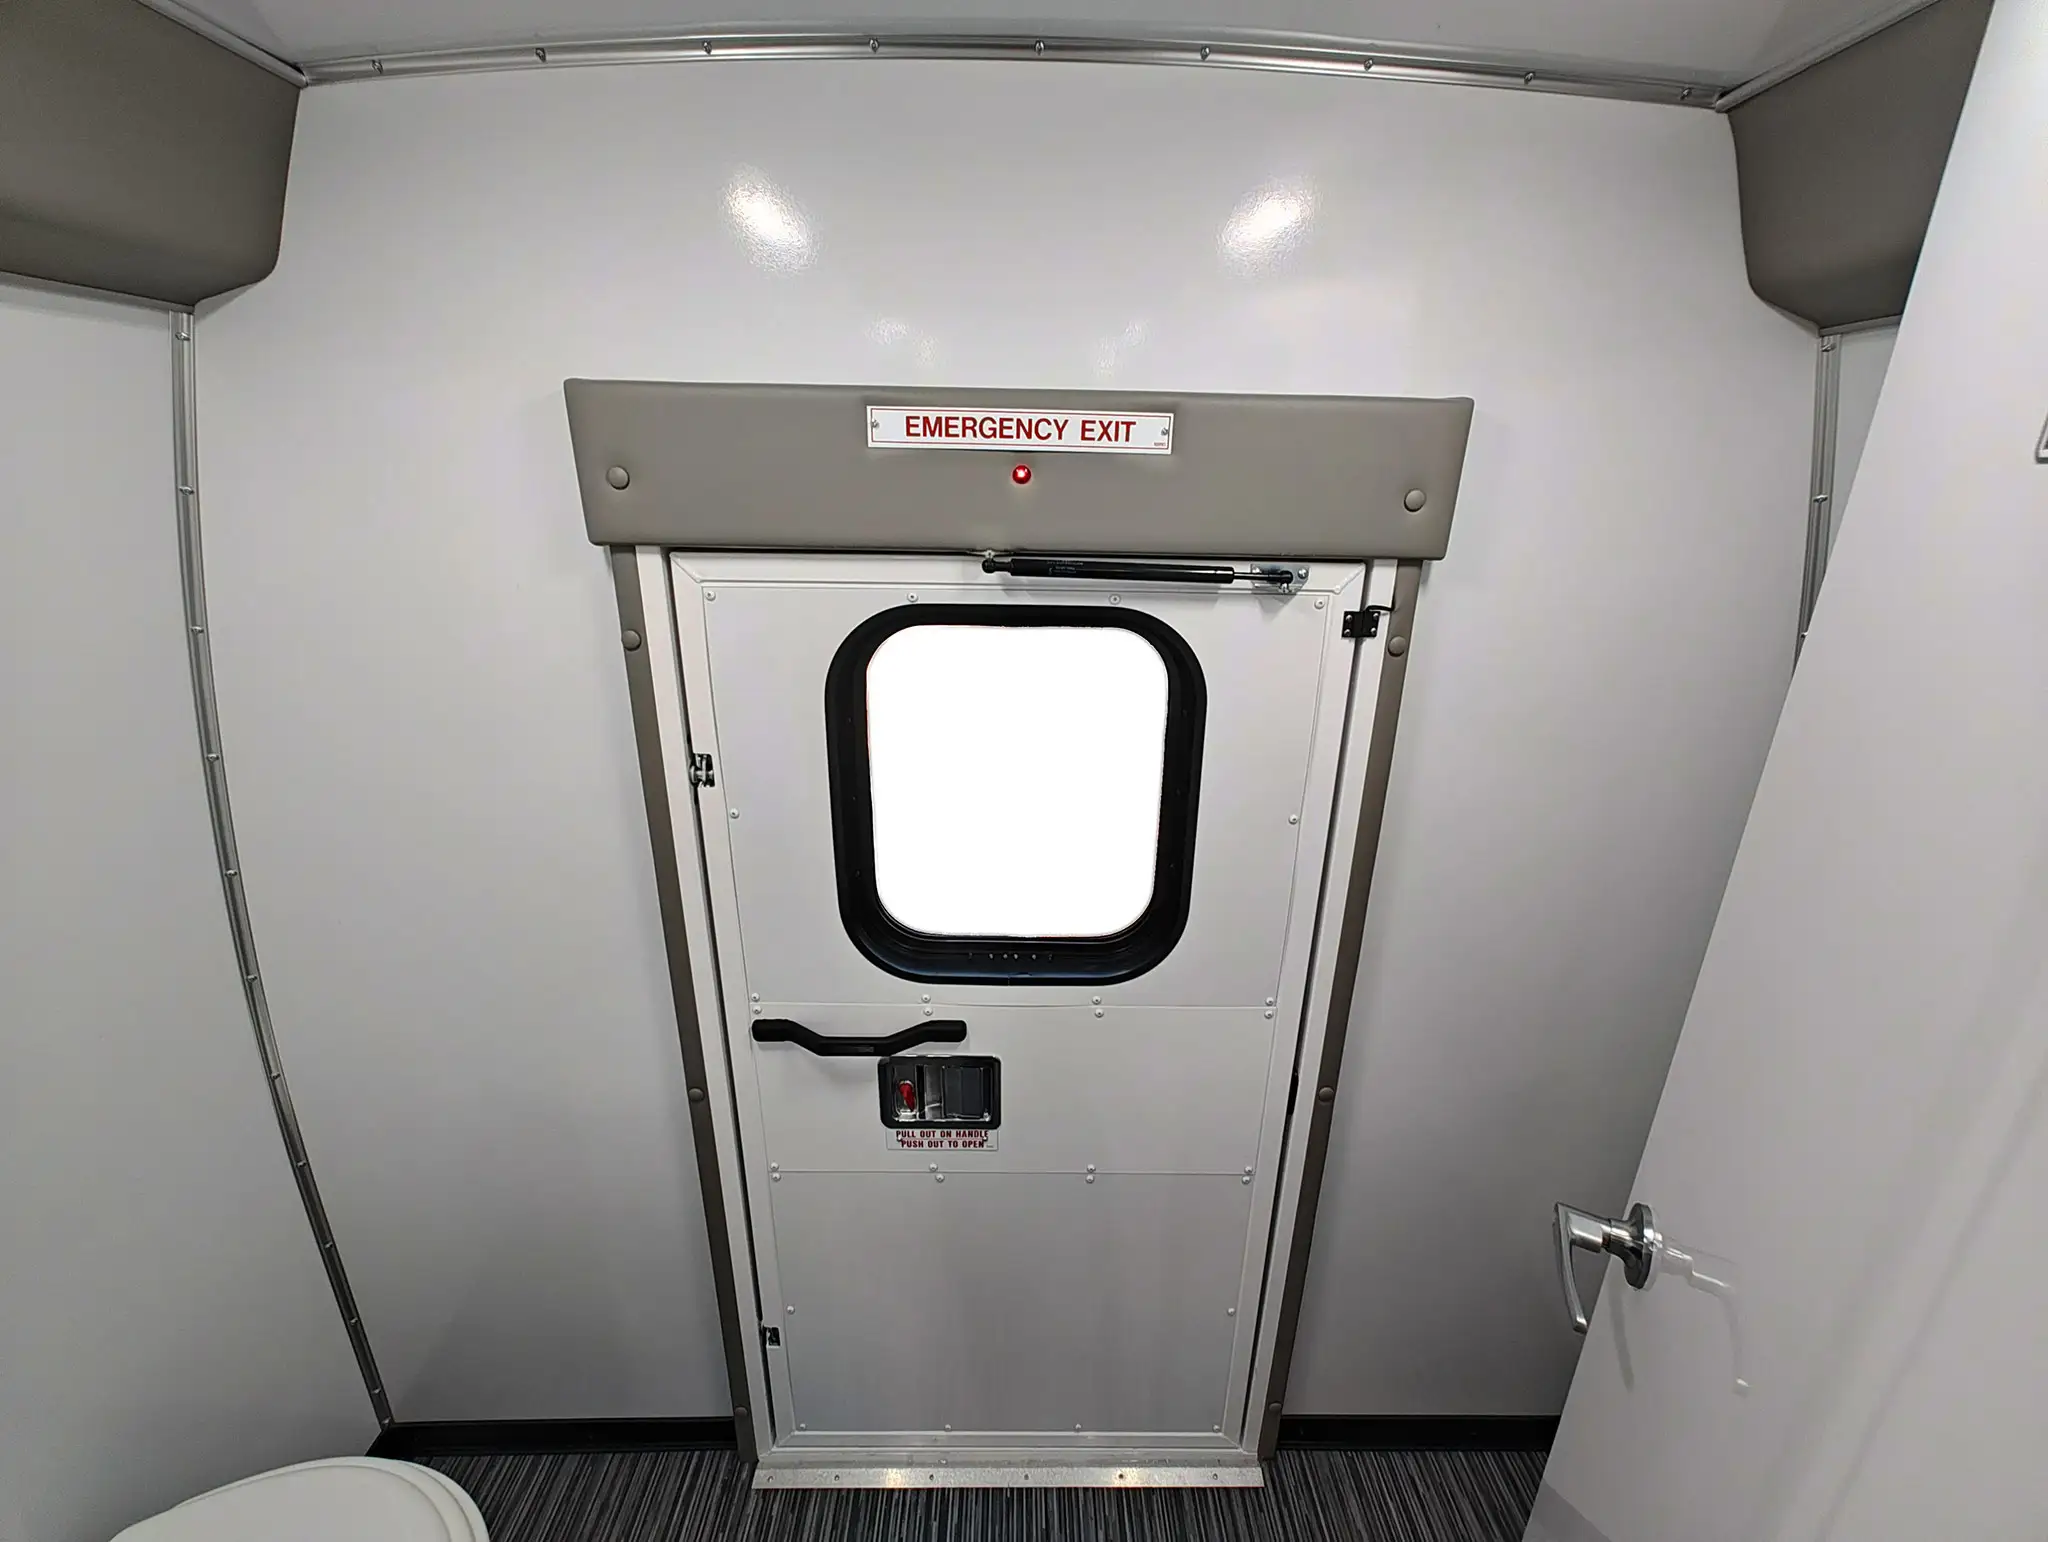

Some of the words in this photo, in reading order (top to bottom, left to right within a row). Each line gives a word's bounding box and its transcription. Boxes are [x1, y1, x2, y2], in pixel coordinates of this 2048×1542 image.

[905, 415, 1069, 441] EMERGENCY
[1080, 420, 1137, 442] EXIT
[896, 1130, 916, 1138] PULL
[920, 1130, 936, 1138] OUT
[940, 1130, 952, 1138] ON
[955, 1130, 989, 1138] HANDLE
[901, 1140, 924, 1148] PUSH
[927, 1140, 944, 1148] OUT
[948, 1140, 959, 1148] TO
[962, 1140, 985, 1148] OPEN
